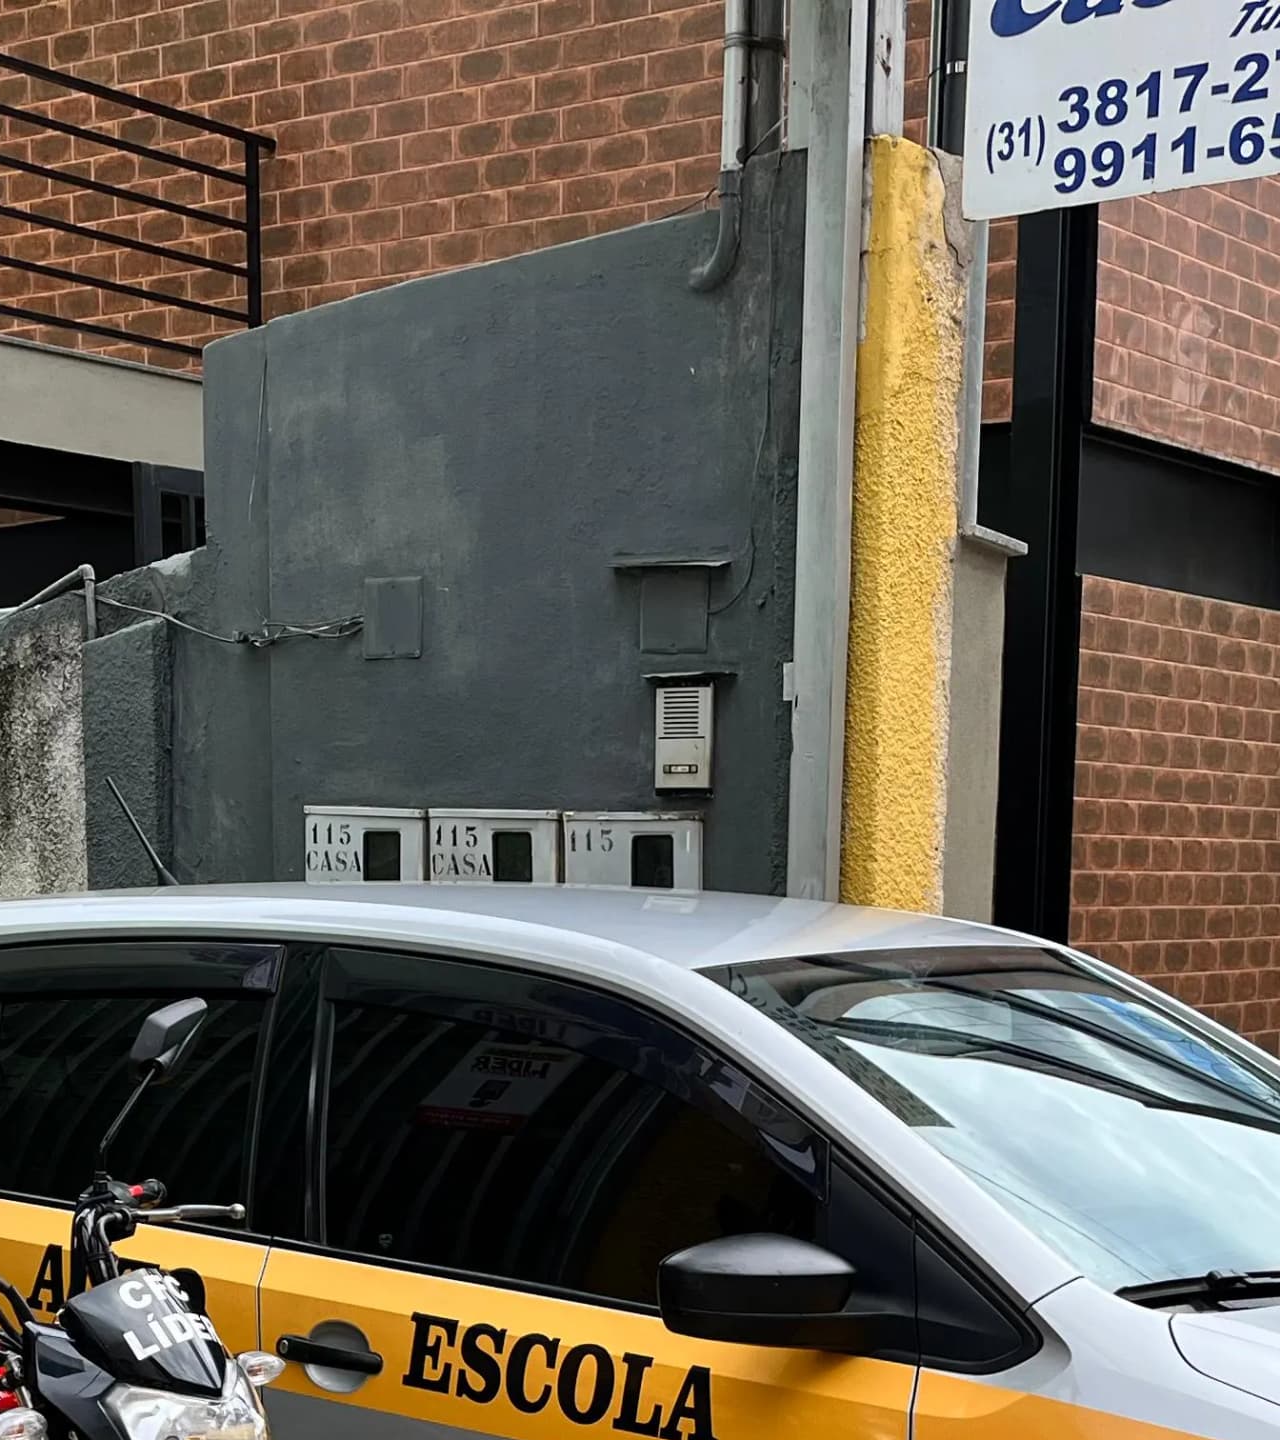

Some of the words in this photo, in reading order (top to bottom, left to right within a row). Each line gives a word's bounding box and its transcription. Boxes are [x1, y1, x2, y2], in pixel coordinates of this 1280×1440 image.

[986, 115, 1046, 174] (31)
[311, 823, 351, 846] 115
[435, 824, 479, 849] 115
[569, 828, 614, 853] 115
[306, 850, 362, 873] CASA
[431, 853, 493, 877] CASA
[119, 1274, 189, 1309] CFC
